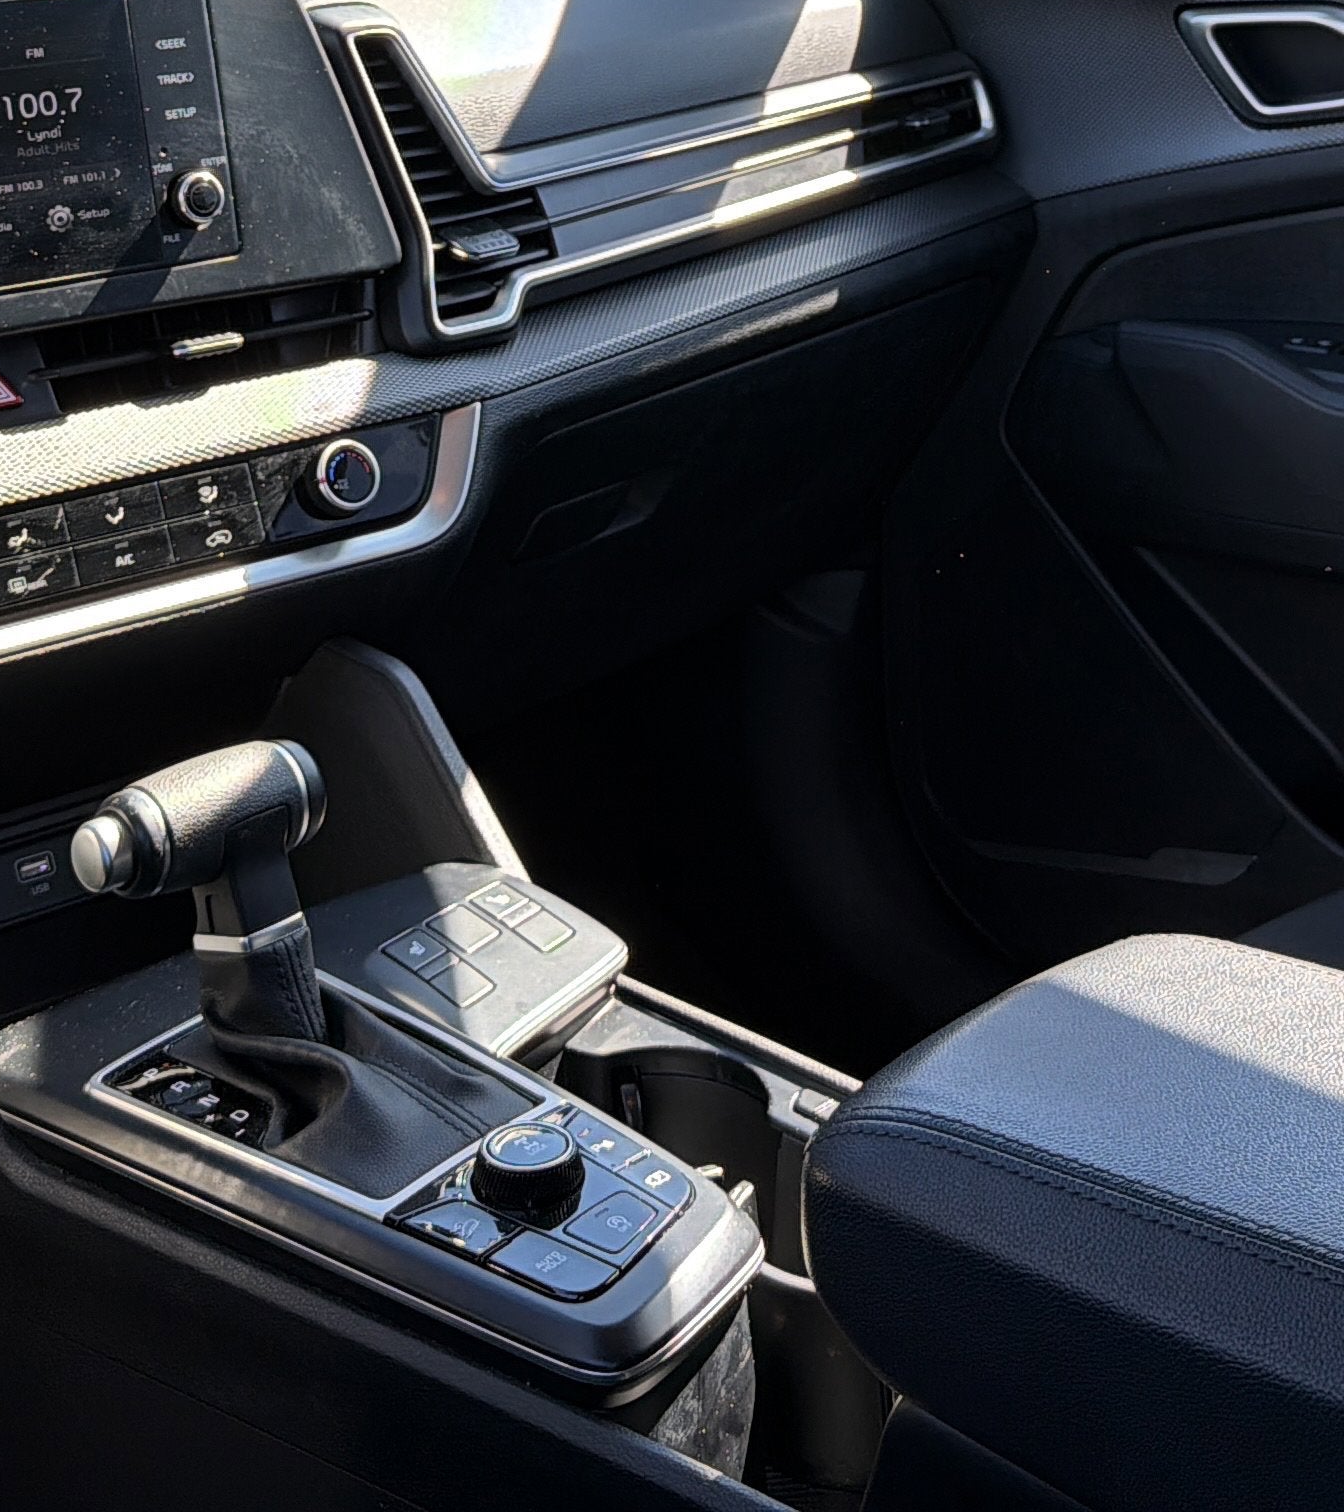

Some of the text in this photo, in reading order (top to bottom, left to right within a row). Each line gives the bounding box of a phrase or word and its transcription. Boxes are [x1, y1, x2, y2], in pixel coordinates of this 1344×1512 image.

[25, 48, 44, 60] FM
[2, 88, 83, 121] 100.7
[165, 106, 196, 121] SETUP
[27, 125, 62, 142] Lyndi
[63, 174, 79, 185] FM
[79, 207, 110, 221] Setup
[115, 553, 135, 567] A/C
[31, 882, 50, 896] USB
[229, 1109, 249, 1122] D
